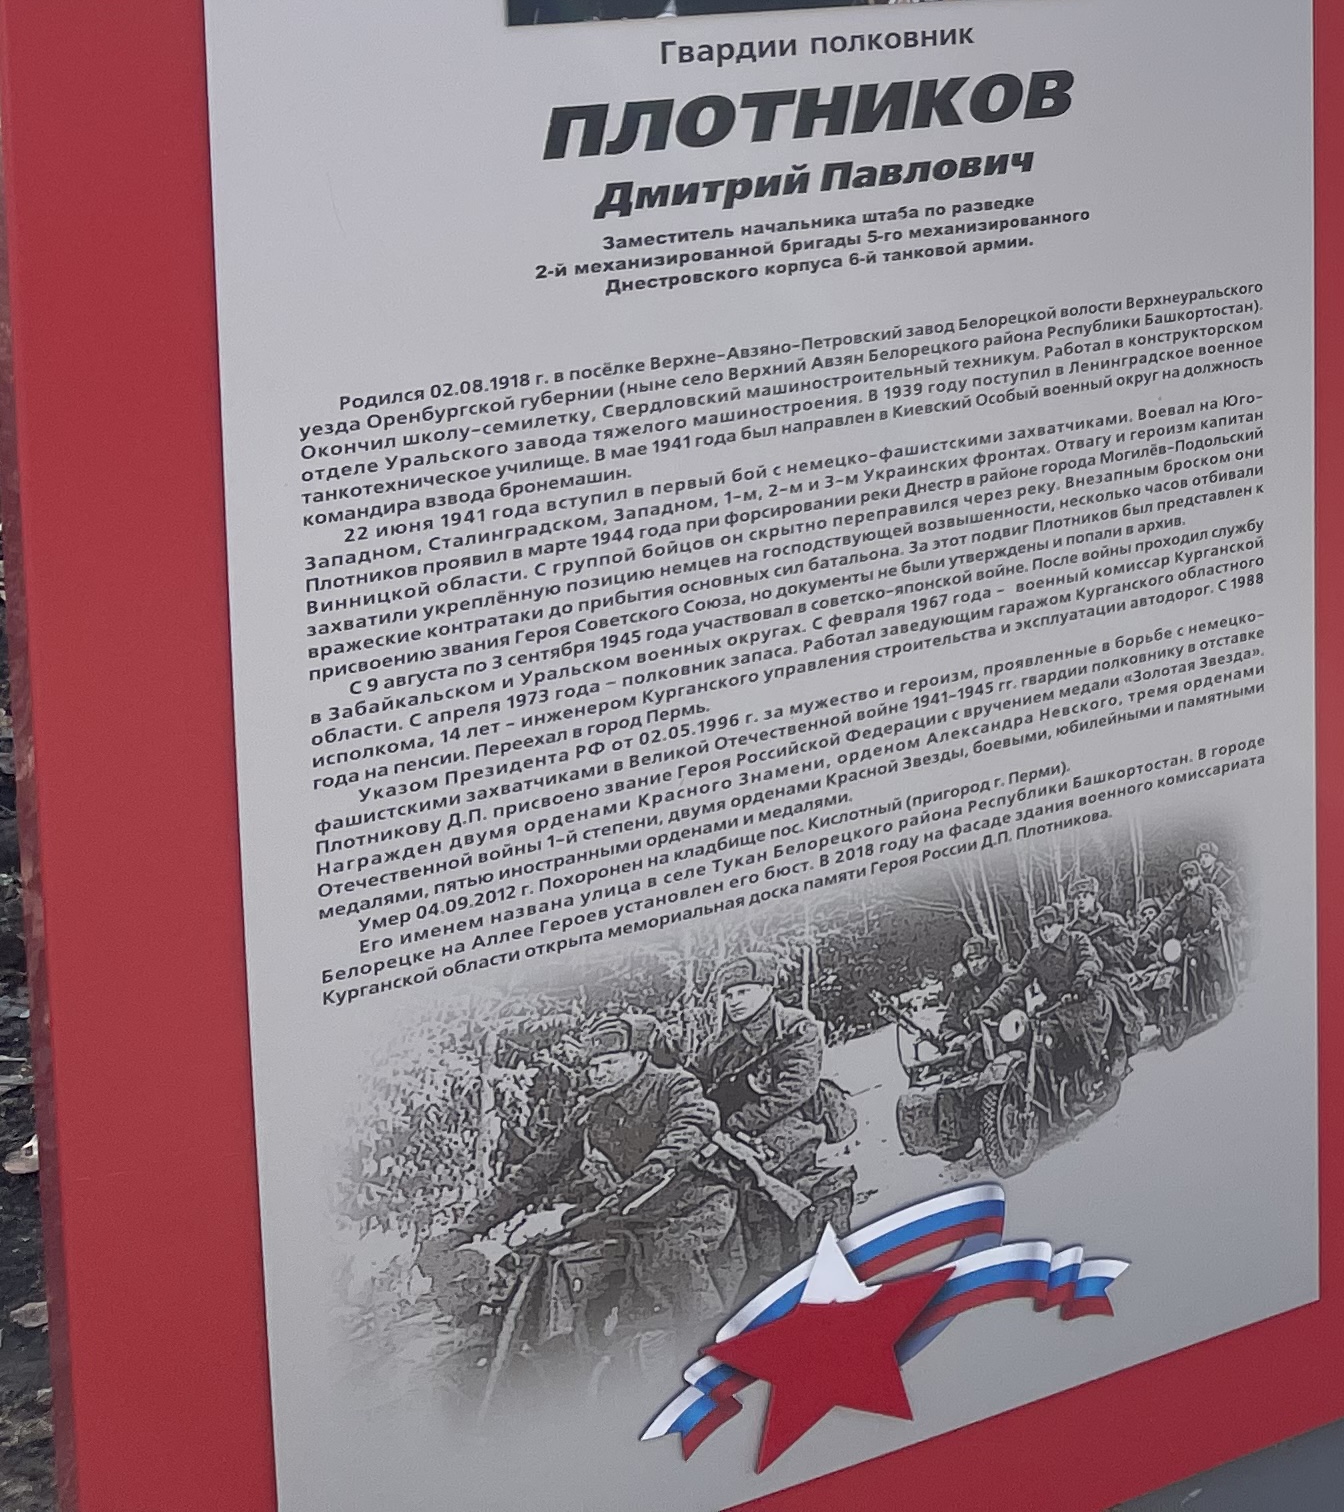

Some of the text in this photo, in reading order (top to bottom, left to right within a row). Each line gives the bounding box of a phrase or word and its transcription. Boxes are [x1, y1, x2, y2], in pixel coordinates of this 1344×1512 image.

[661, 27, 974, 67] Гвардии полковник
[542, 69, 1074, 160] ПЛОТНИКОВ
[535, 210, 1089, 279] 2-й механизированной бригады 5-го механизированного
[593, 151, 1034, 219] Дмитрий Павлович
[602, 196, 1034, 250] Заместитель начальника штаба по разведке
[605, 237, 1033, 296] Днестровского корпуса 6-й танковой армии.
[298, 299, 1262, 442] уезда Оренбургской губернии (ныне село Верхний Авзян Белорецкого района Республики Башкортостан).
[300, 319, 1262, 459] Окончил школу-семилетку, Свердловский машиностроительный техникум. Работал в конструкторском
[339, 389, 424, 410] Родился
[430, 372, 530, 398] 02.08.1918
[535, 373, 548, 385] г.
[553, 371, 564, 382] в
[569, 361, 645, 380] посёлке
[906, 322, 955, 337] завод
[958, 305, 1056, 330] Белорецкой
[1060, 300, 1121, 317] волости
[1126, 283, 1262, 310] Верхнеуральского
[343, 525, 368, 542] 22
[376, 519, 433, 537] июня
[440, 508, 484, 527] 1941
[492, 503, 539, 519] года
[546, 489, 627, 511] вступил
[634, 487, 643, 497] в
[650, 470, 725, 495] первый
[731, 464, 766, 482] бой
[772, 465, 781, 476] с
[1007, 413, 1132, 440] захватчиками.
[1137, 403, 1194, 420] Воевал
[1199, 399, 1217, 411] на
[316, 665, 1264, 876] Награжден двумя орденами Красного Знамени, орденом Александра Невского, тремя орденами
[318, 792, 852, 919] медалями, пятью иностранными орденами и медалями.
[322, 809, 1112, 1006] Курганской области открыта мемориальная доска памяти Героя России Д.П. Плотникова.
